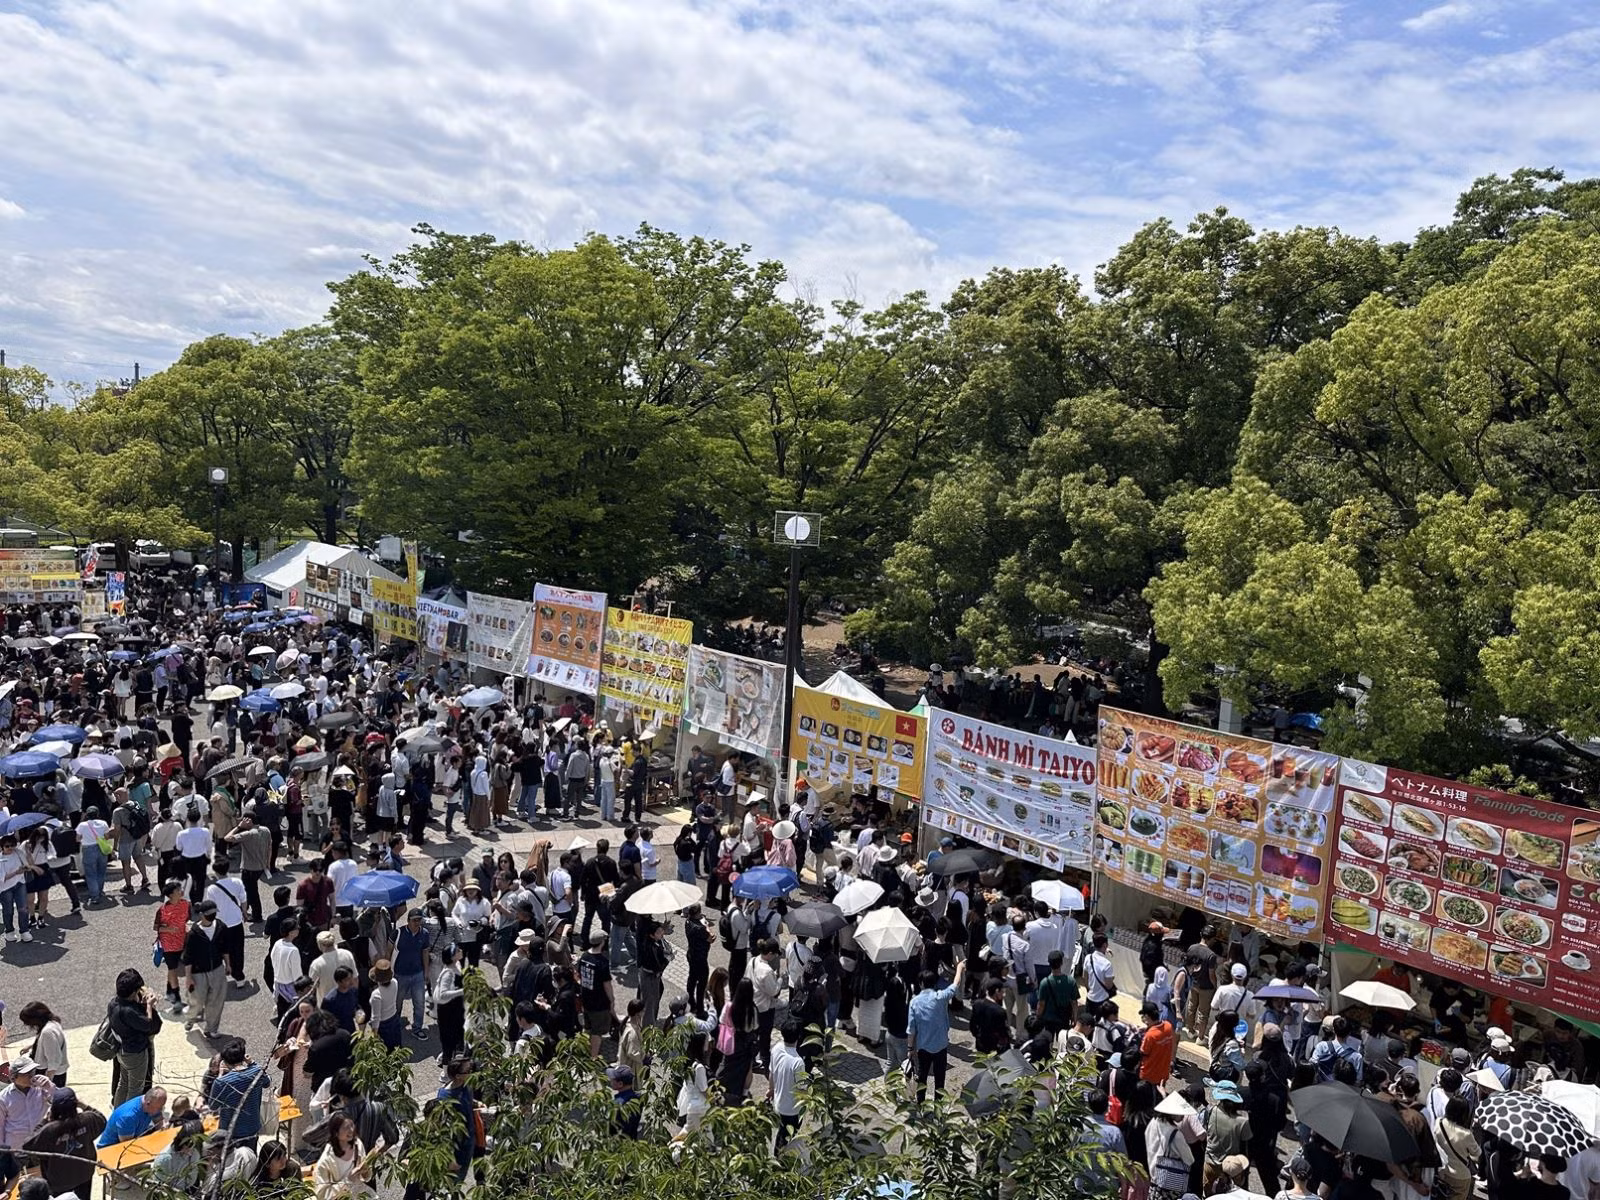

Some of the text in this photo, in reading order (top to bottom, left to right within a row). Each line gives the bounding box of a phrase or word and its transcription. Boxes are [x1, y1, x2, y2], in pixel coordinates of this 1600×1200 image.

[962, 726, 1096, 785] BÁNH MÌ TAIYO
[1392, 776, 1468, 802] ベトナム料理
[1472, 794, 1566, 823] FamilyFoods
